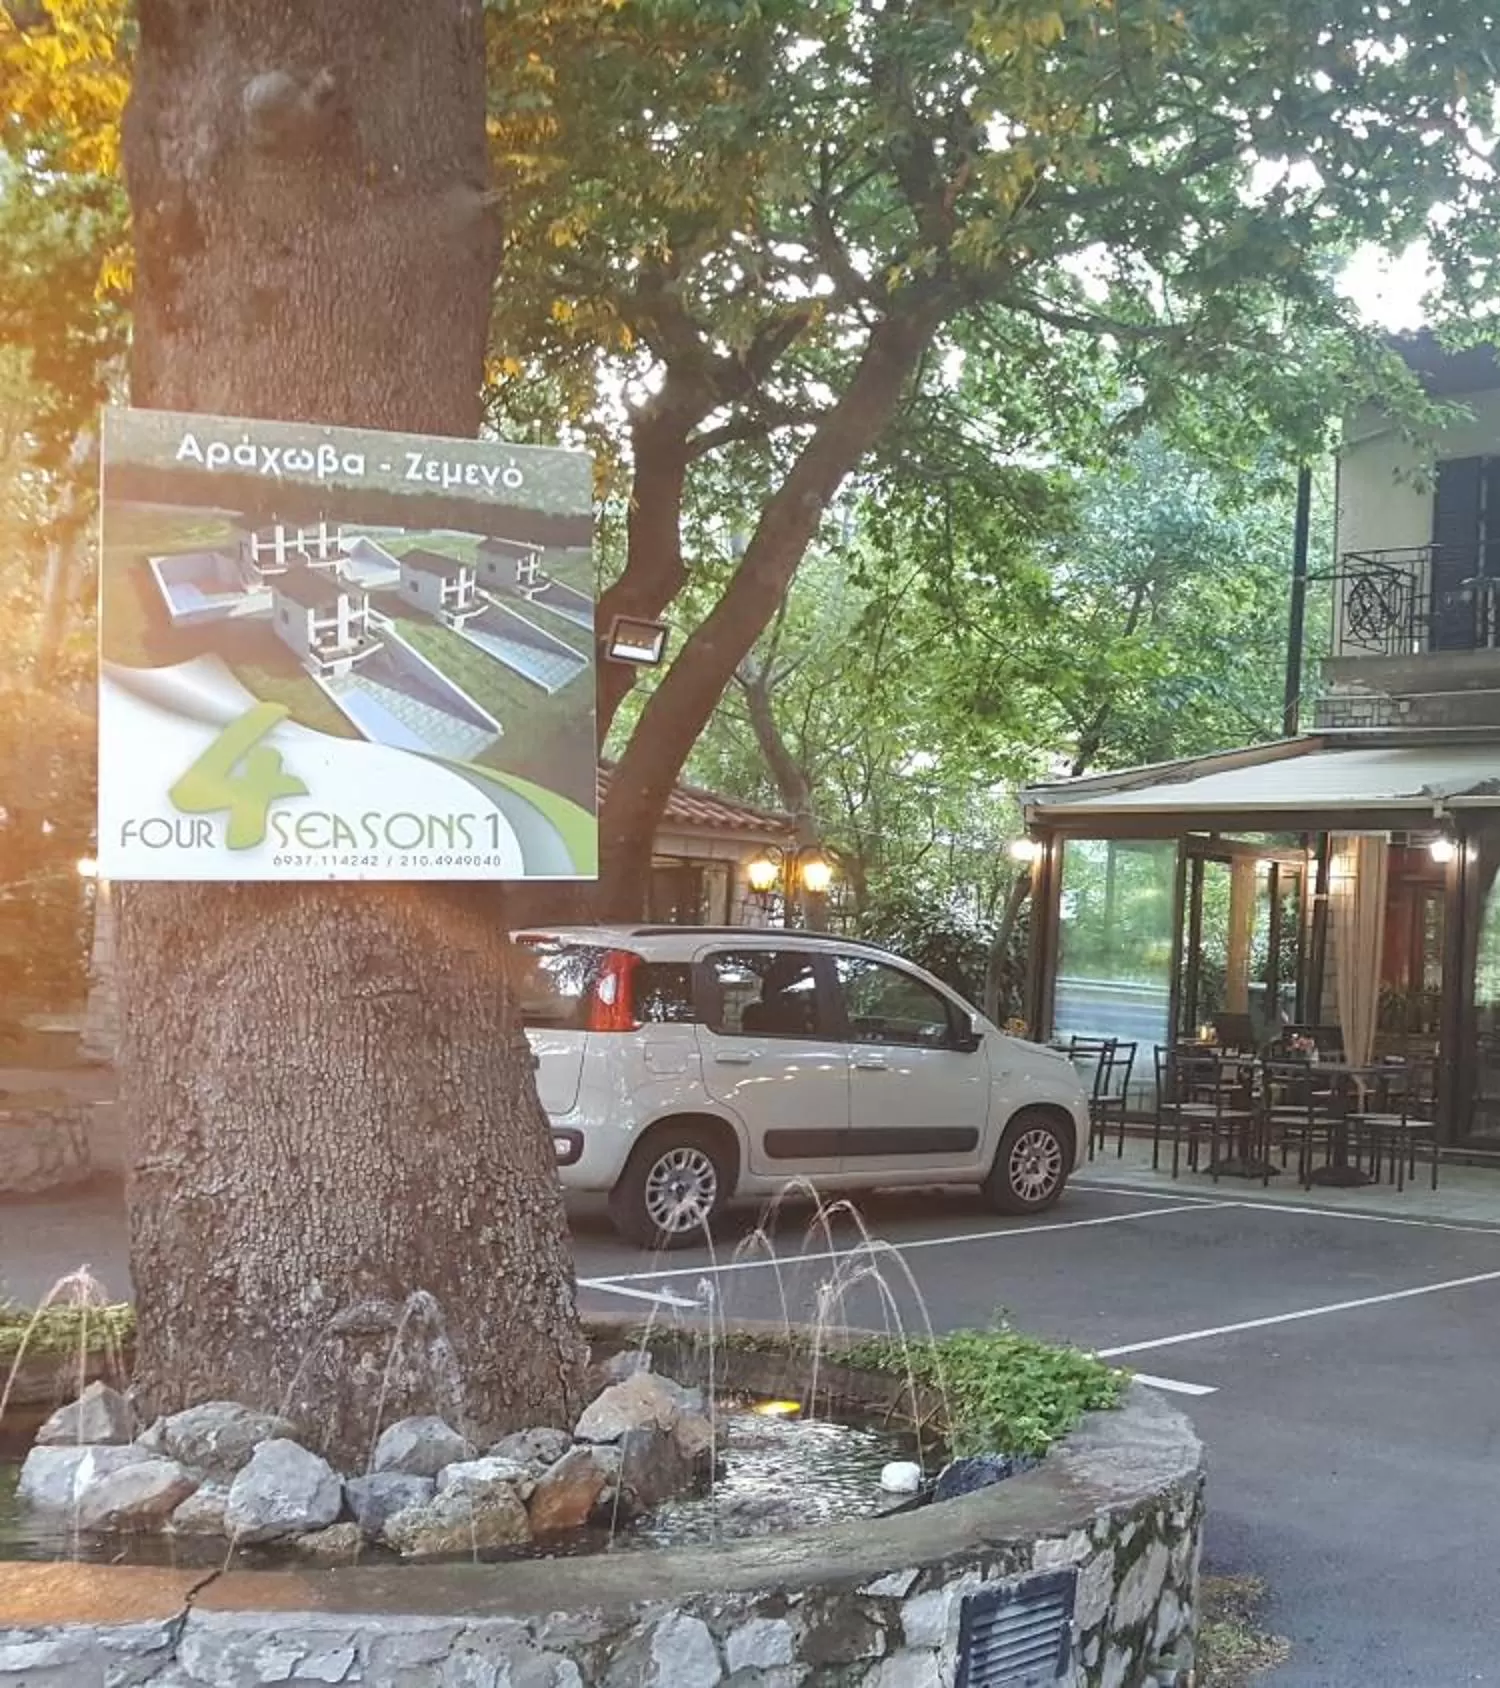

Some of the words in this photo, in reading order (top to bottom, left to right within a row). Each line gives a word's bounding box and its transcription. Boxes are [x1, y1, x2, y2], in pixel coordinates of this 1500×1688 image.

[175, 432, 366, 479] Αράχωβα
[405, 451, 524, 489] Ζεμενό
[120, 817, 216, 849] FOUR
